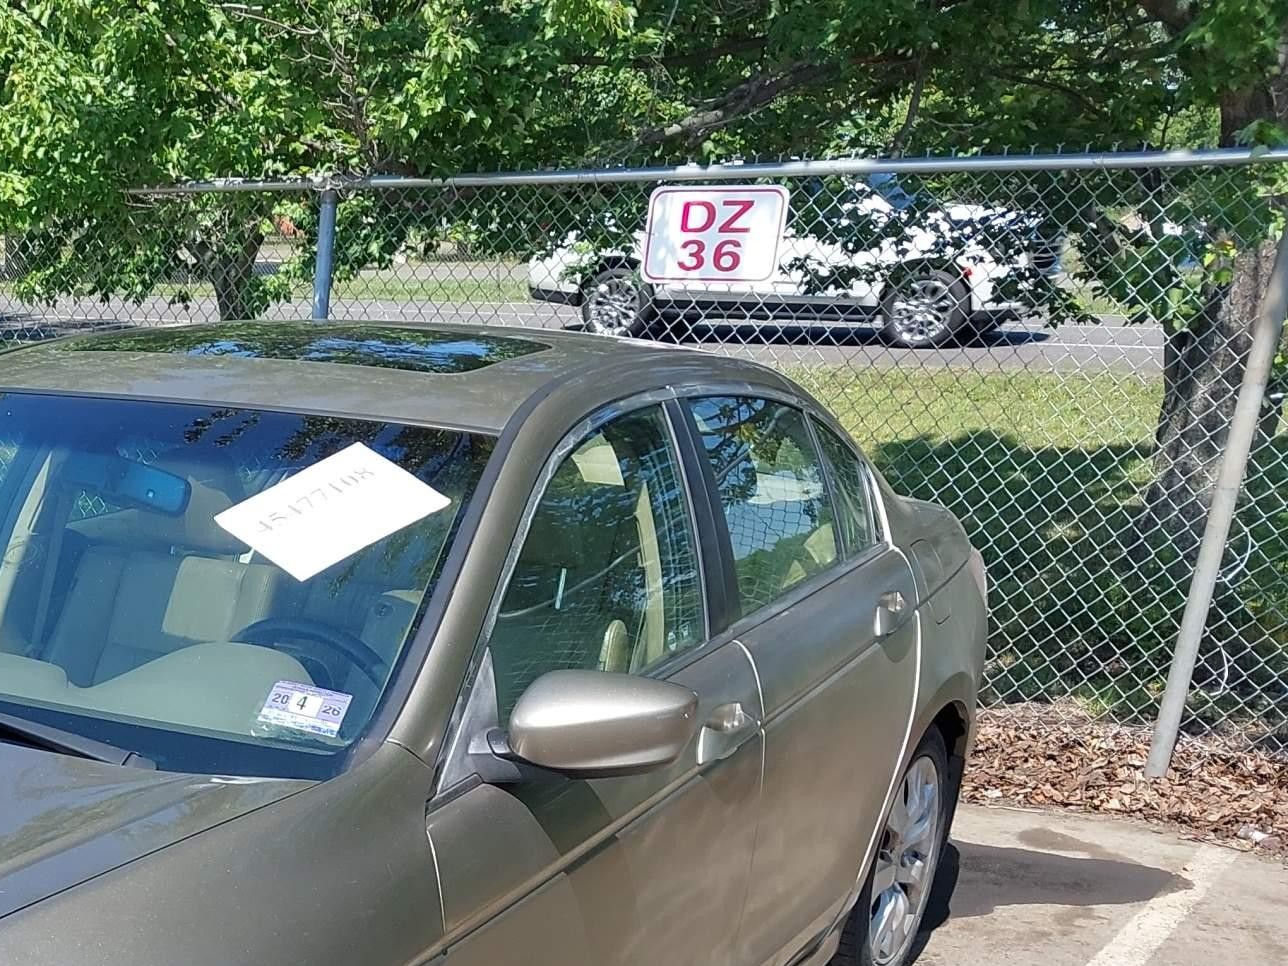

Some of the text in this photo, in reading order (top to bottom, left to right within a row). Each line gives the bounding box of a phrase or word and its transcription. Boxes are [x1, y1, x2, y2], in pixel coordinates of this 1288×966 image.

[680, 200, 755, 233] DZ
[677, 239, 742, 272] 36
[272, 692, 342, 717] 20 4 26
